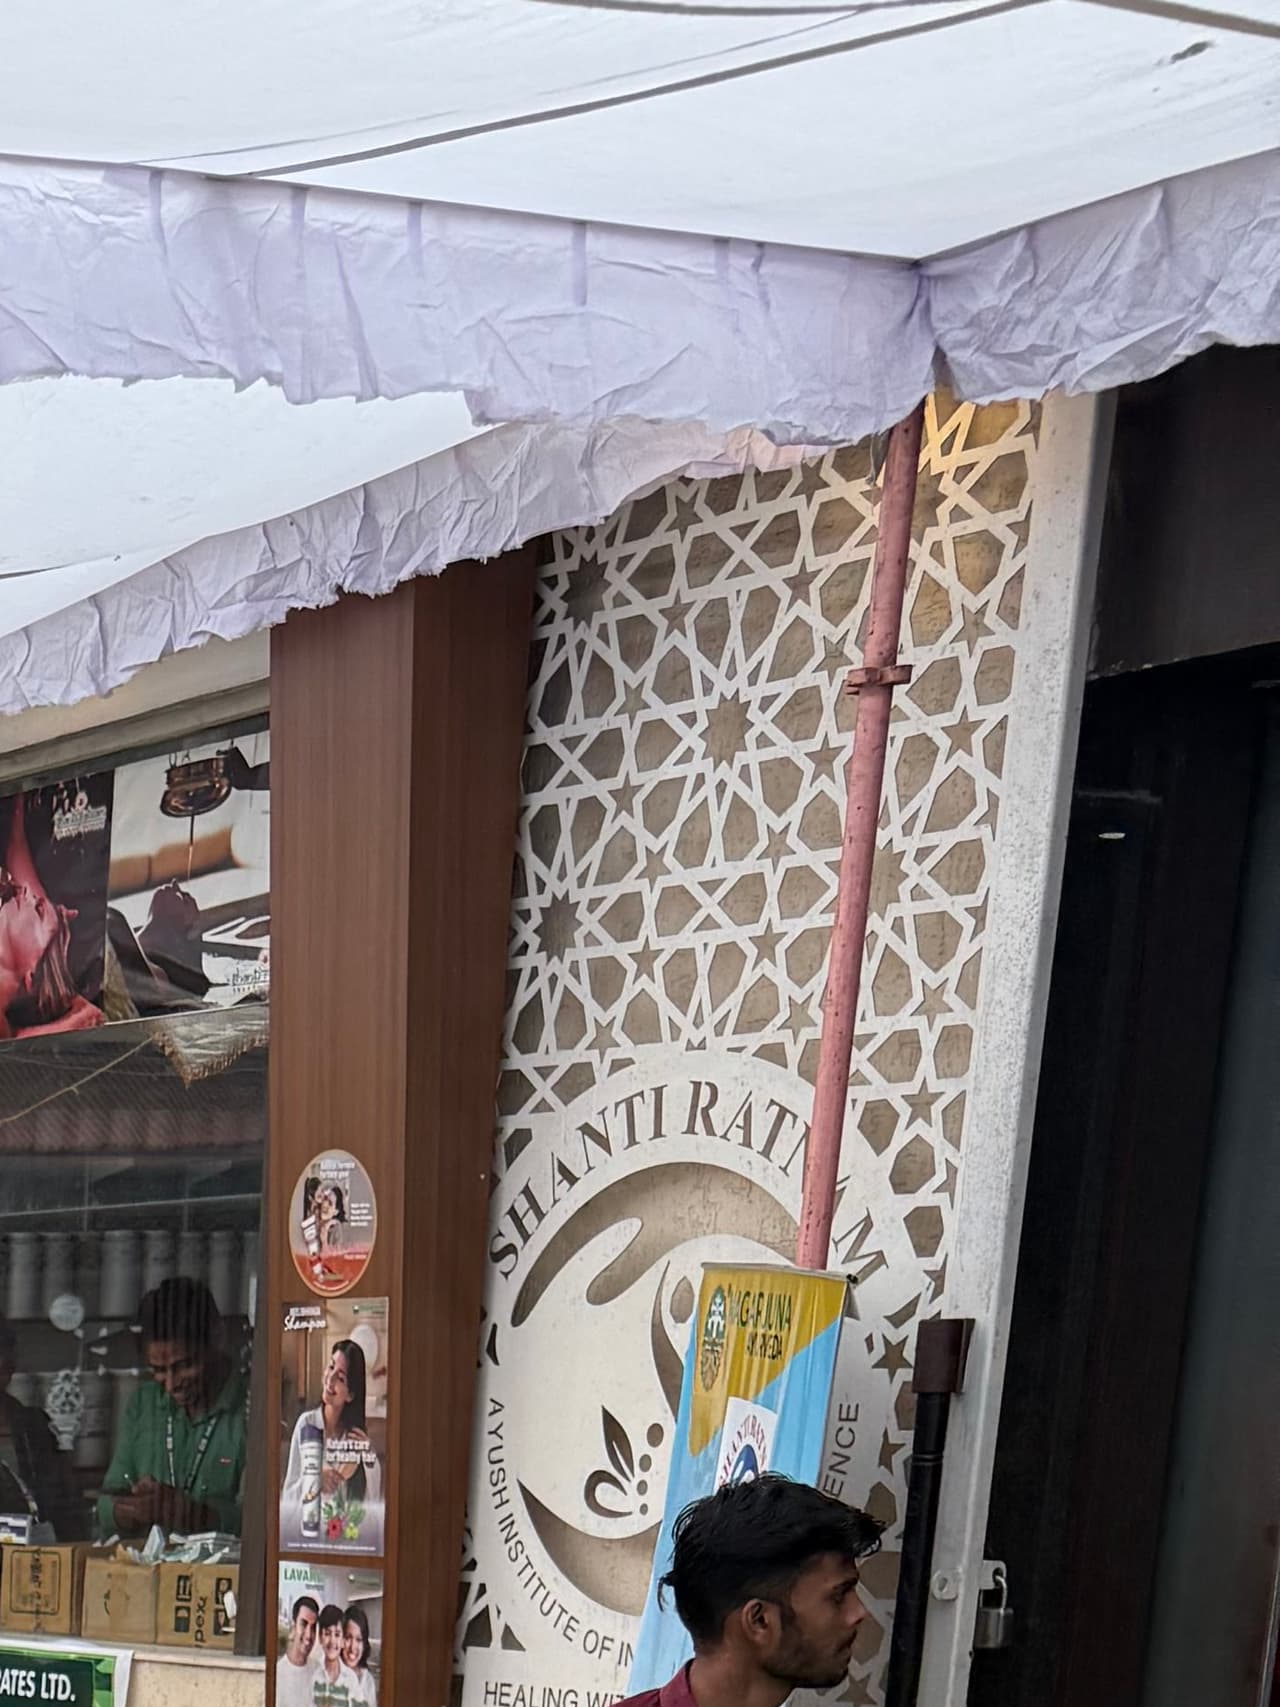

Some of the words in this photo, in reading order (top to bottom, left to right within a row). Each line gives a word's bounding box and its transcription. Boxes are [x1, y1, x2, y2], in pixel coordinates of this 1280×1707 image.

[488, 1080, 669, 1281] SHANTI
[680, 1079, 889, 1289] RATM
[283, 1314, 328, 1333] Shampoo
[485, 1396, 511, 1509] AYUSH
[497, 1509, 585, 1642] INSTITUTE
[582, 1628, 615, 1666] OF
[40, 1671, 77, 1702] LTD.
